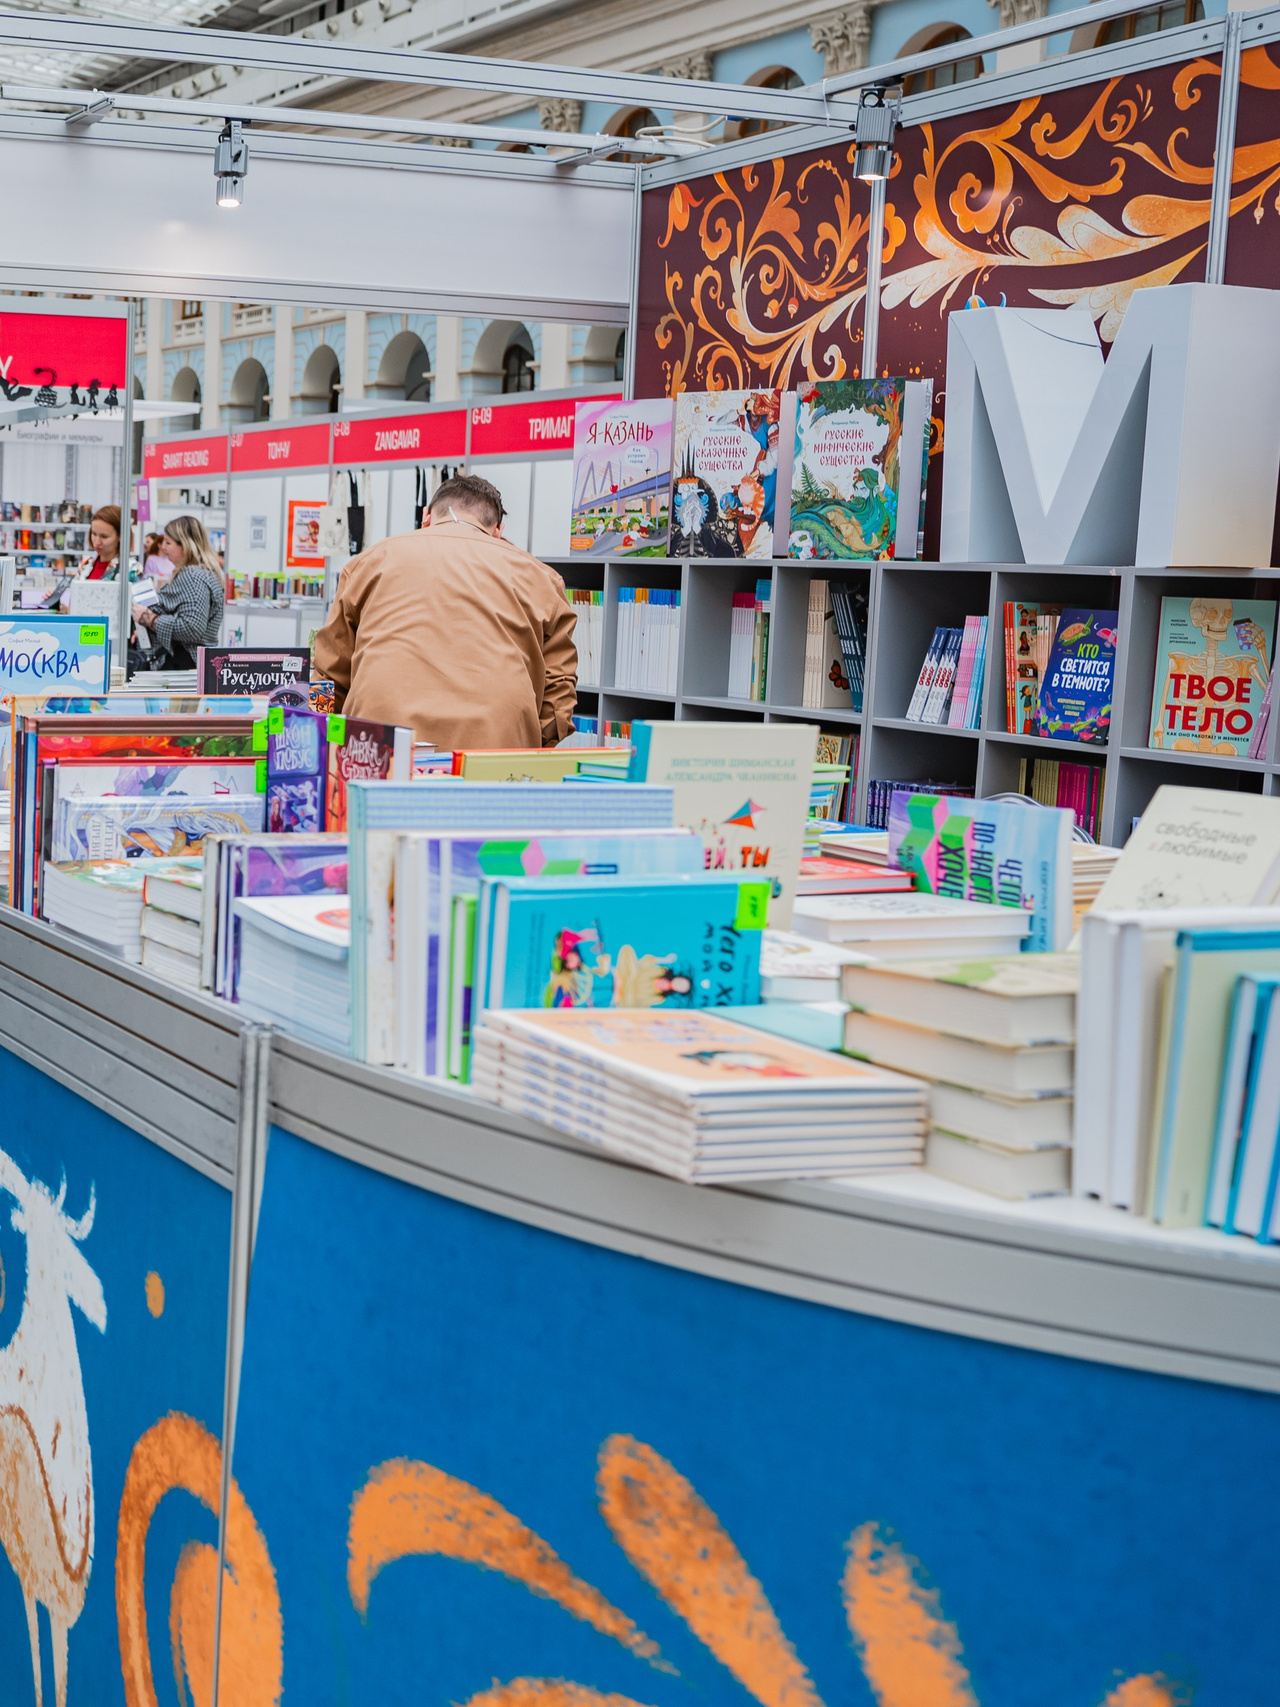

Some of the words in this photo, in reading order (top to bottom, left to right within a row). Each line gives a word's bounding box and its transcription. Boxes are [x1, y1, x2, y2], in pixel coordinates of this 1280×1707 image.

[472, 407, 492, 425] G-09
[333, 421, 350, 436] G-08
[586, 420, 654, 446] Я-КАЗАНЬ
[824, 429, 864, 440] РУССКИЕ
[375, 428, 420, 451] ZANGAVAR
[703, 435, 741, 446] РУССКИЕ
[813, 441, 874, 453] МИФИЧЕСКИЕ
[162, 452, 183, 469] SMART
[695, 447, 748, 458] СКАЗОЧНЫЕ
[820, 455, 865, 467] СУЩЕСТВА
[698, 460, 743, 472] СУЩЕСТВА
[1077, 643, 1100, 659] КТО
[1060, 658, 1110, 676] СВЕТИТСЯ
[1051, 673, 1060, 687] В
[1061, 674, 1110, 692] ТЕМНОТЕ?
[1170, 673, 1252, 703] ТВОЕ
[1165, 704, 1253, 735] ТЕЛО
[740, 846, 770, 868] ТЫ
[997, 858, 1023, 904] ЧЕГО
